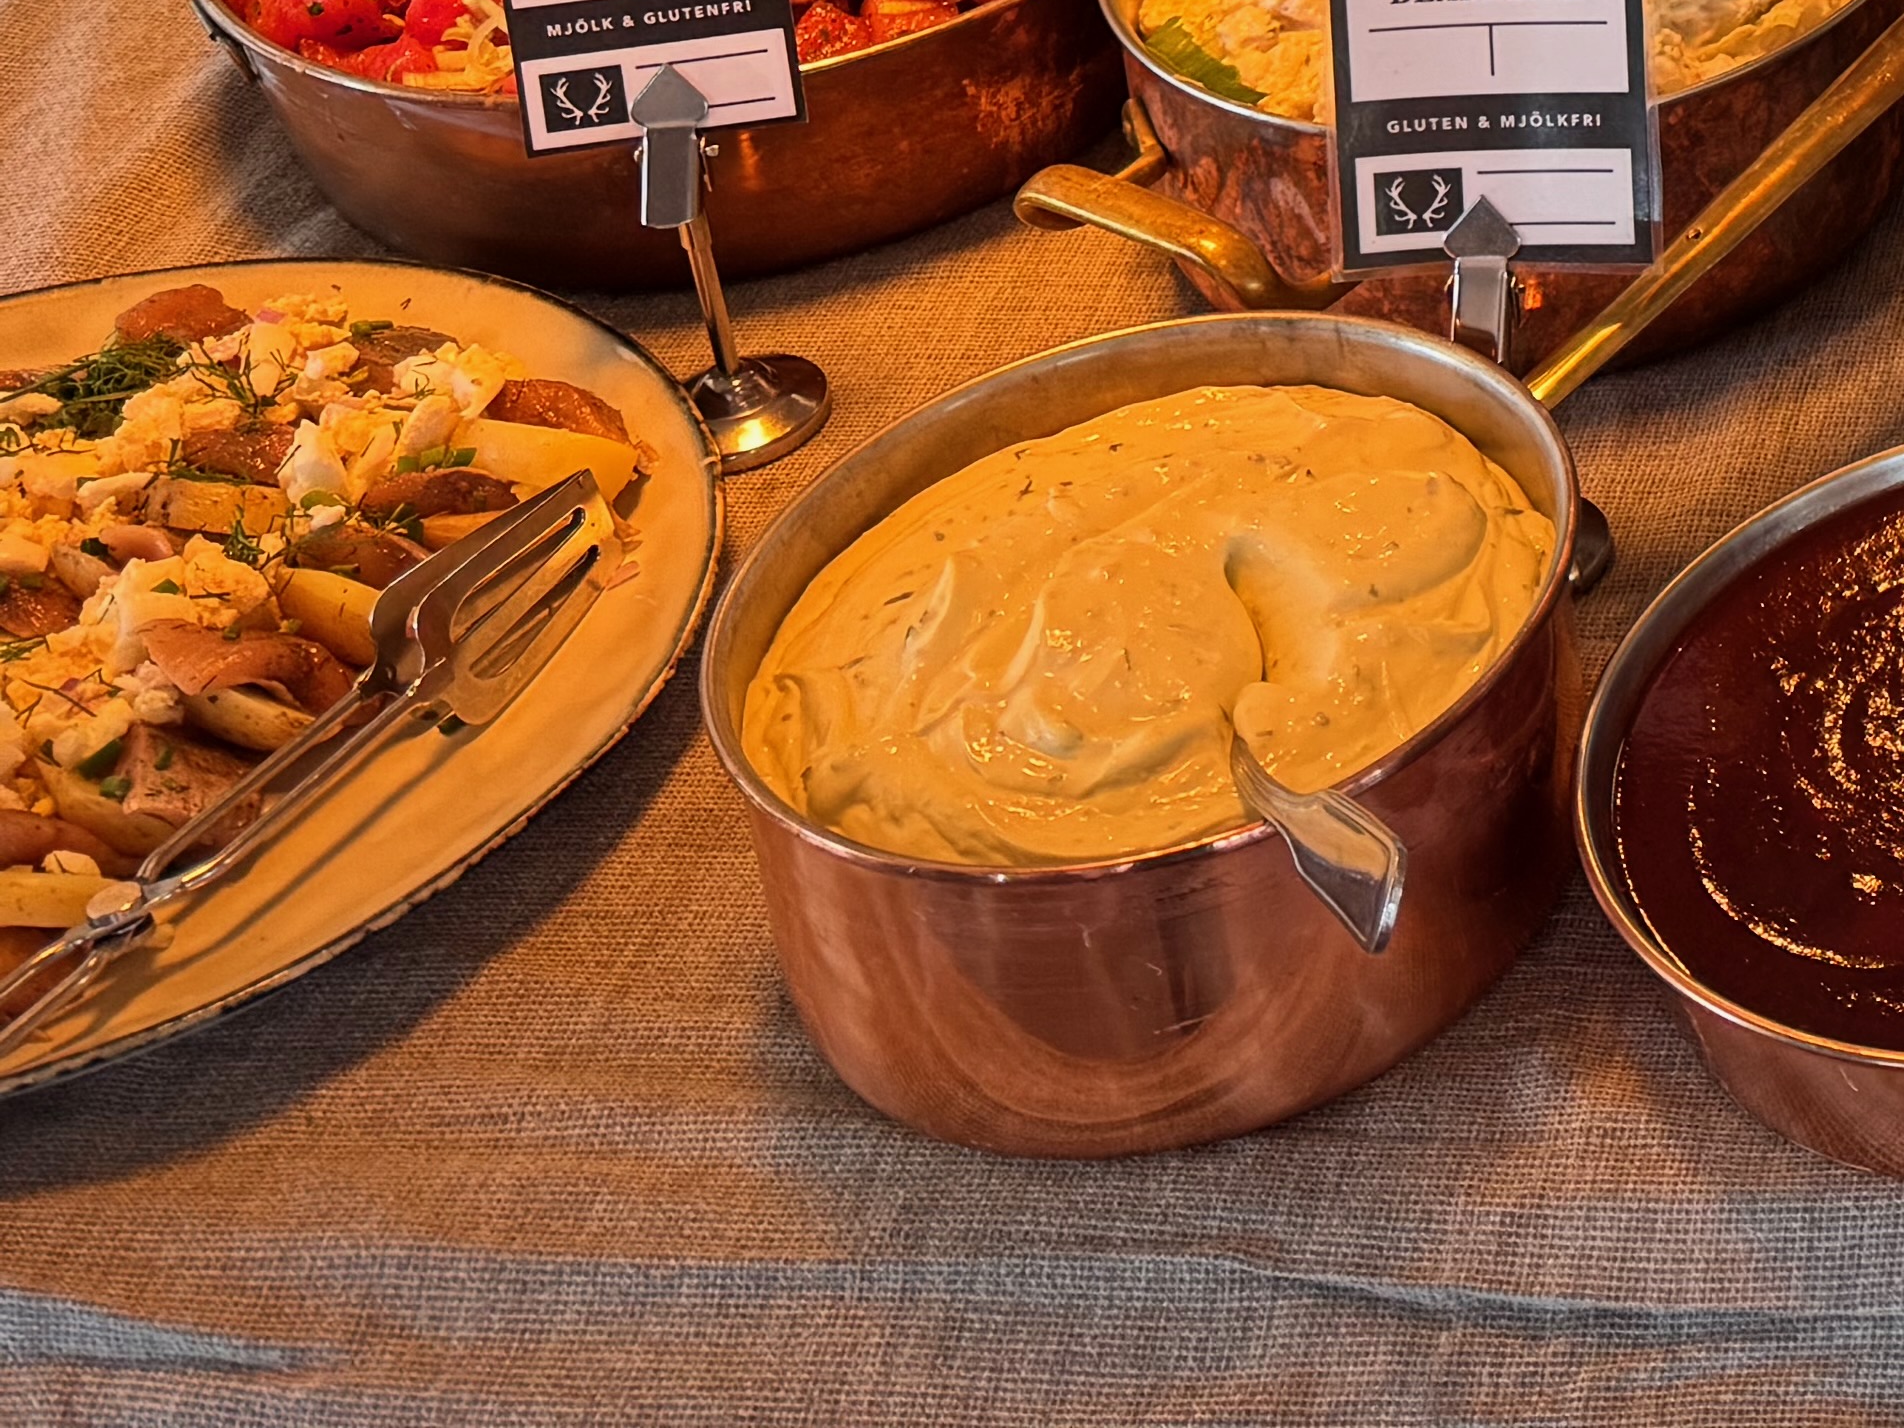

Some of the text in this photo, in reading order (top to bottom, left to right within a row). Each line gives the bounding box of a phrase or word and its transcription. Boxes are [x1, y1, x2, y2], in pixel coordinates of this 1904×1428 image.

[547, 0, 751, 37] MJÖLK & GLUTENFRI
[1387, 111, 1601, 133] GLUTEN & MJÖLKFRI
